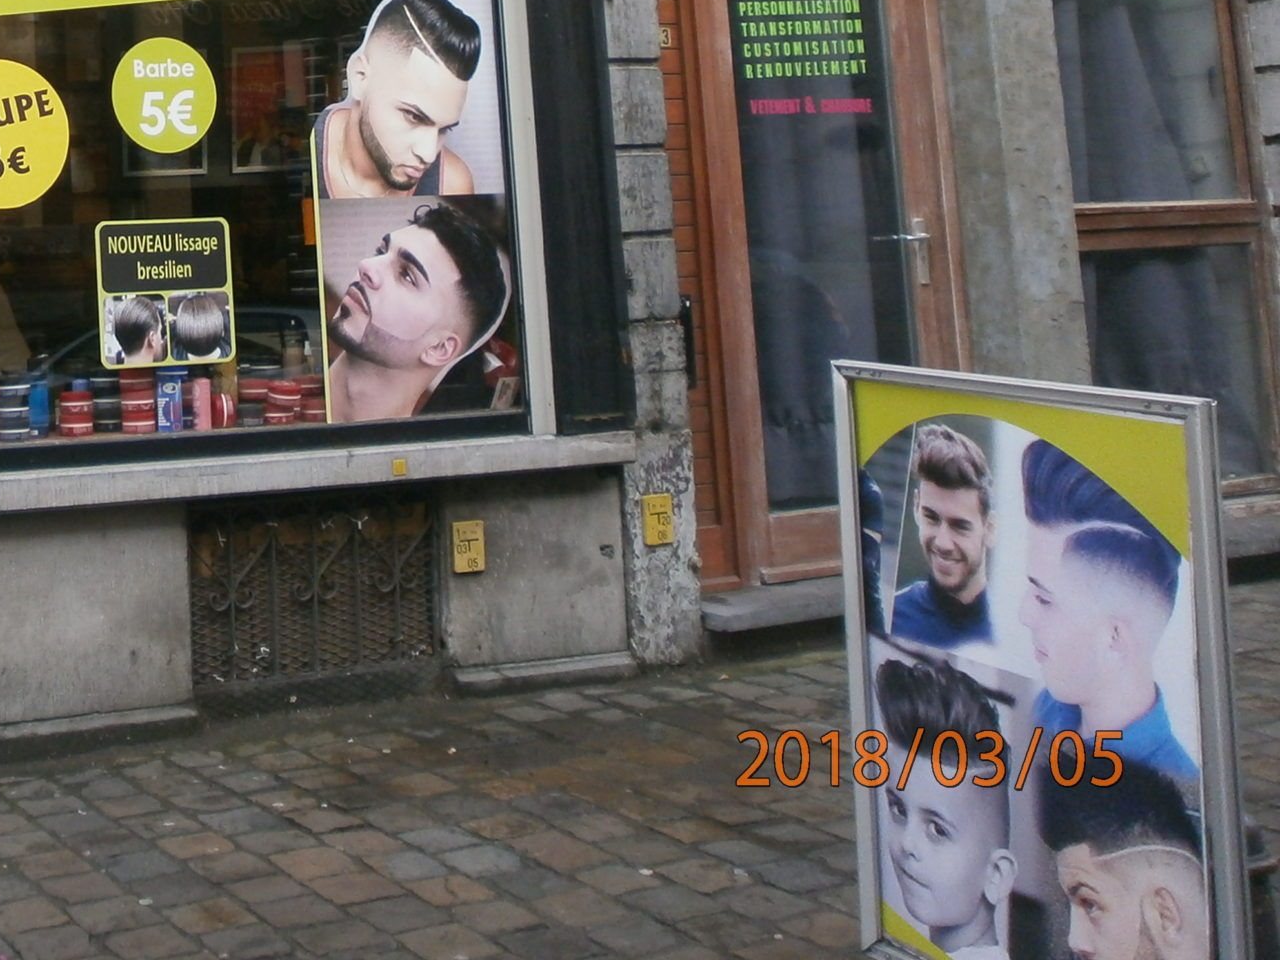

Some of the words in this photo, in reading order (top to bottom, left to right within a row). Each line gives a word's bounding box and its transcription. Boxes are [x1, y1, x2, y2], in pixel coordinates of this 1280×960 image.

[739, 0, 861, 16] PERSONNALISATION
[741, 19, 863, 37] TRANSFORMATION
[743, 39, 865, 58] CUSTOMISATION
[133, 58, 195, 79] Barbe
[745, 59, 867, 79] RENOUVELEMENT
[139, 90, 198, 137] 5€
[108, 234, 172, 254] NOUVEAU
[175, 233, 218, 255] lissage
[137, 260, 192, 280] bresilien
